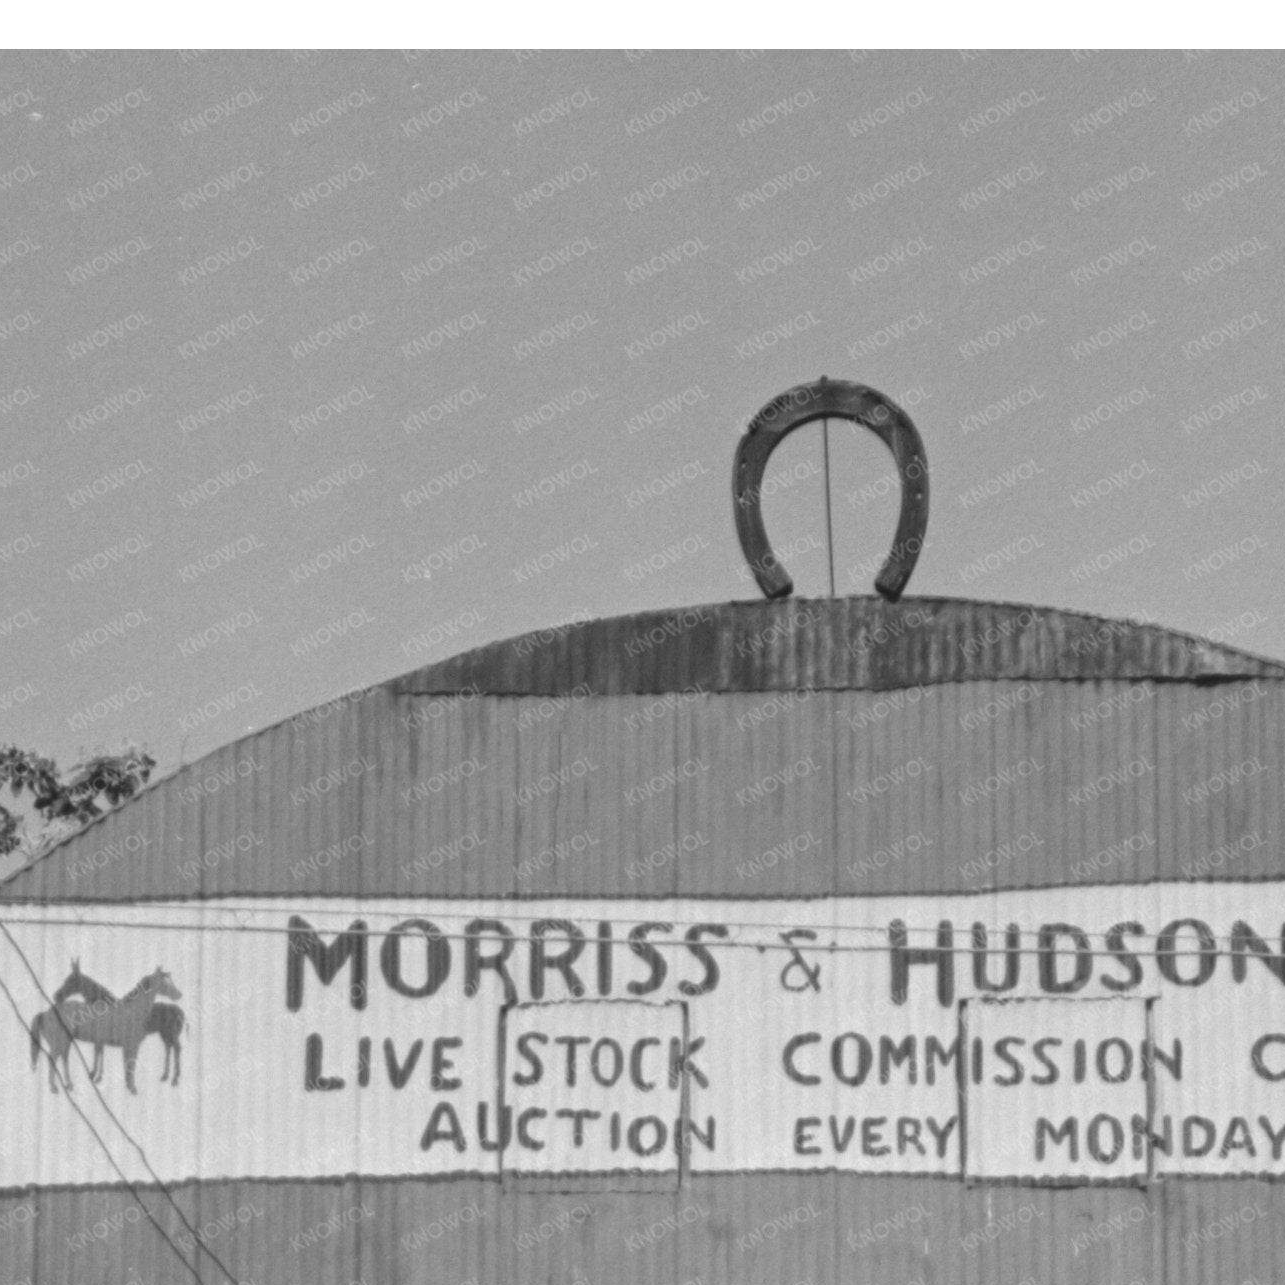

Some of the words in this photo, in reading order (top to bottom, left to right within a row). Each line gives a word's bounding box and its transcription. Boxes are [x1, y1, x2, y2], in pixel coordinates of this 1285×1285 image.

[286, 914, 729, 1012] MORRISS
[780, 928, 822, 993] &
[304, 1032, 464, 1092] LIVE
[512, 1031, 710, 1092] STOCK
[781, 1031, 1184, 1088] COMMISSION
[419, 1100, 716, 1157] AUCTION
[792, 1114, 959, 1159] EVERY
